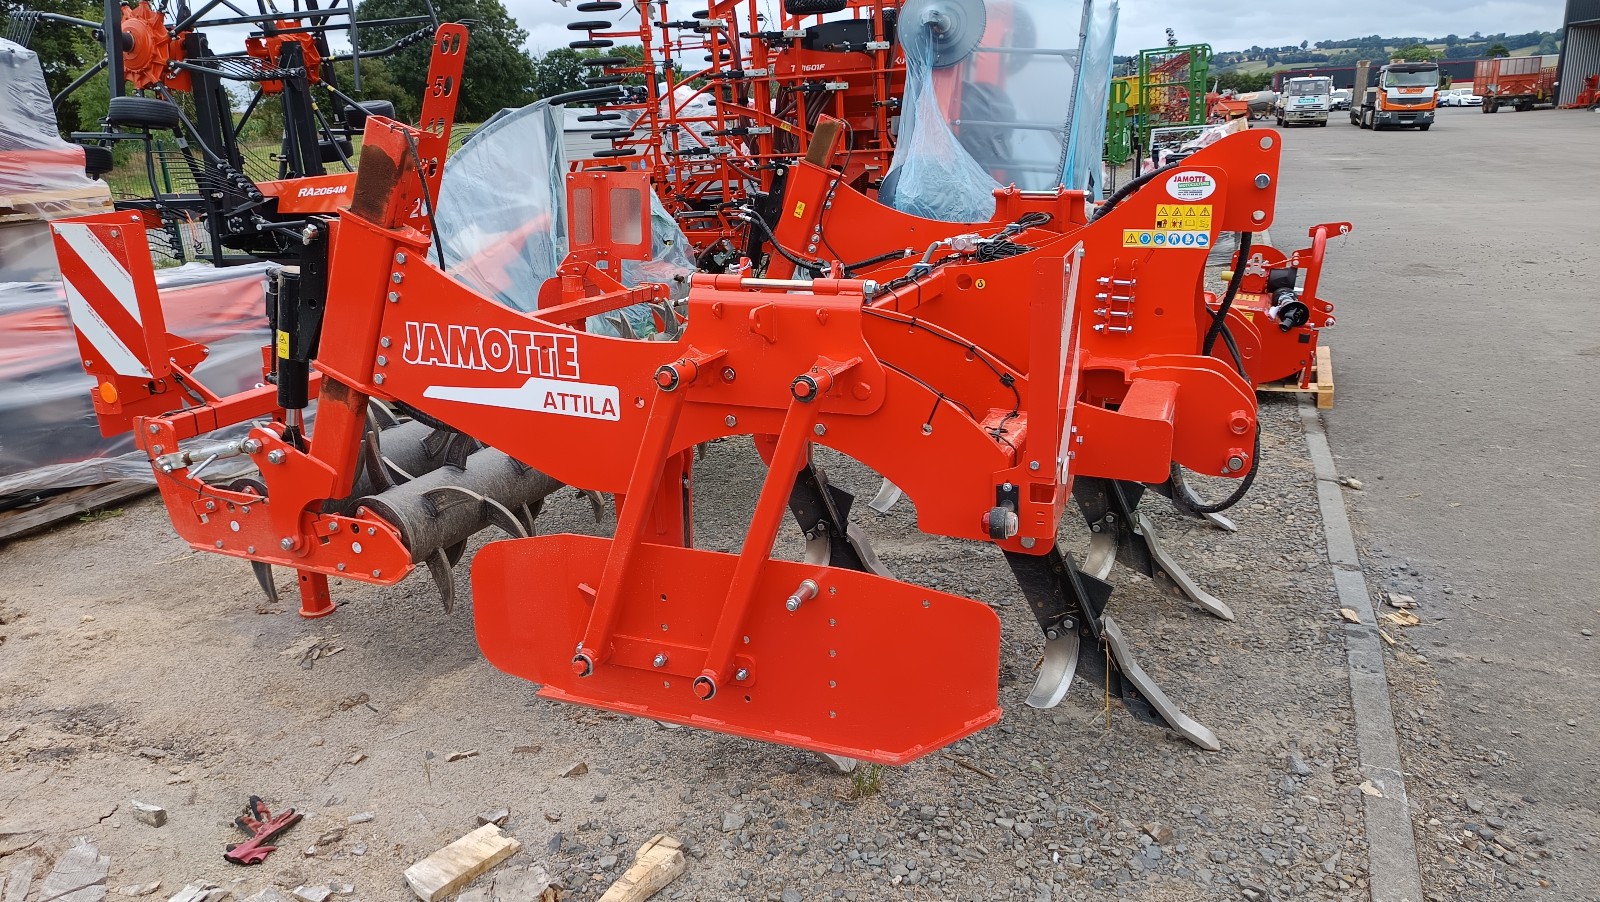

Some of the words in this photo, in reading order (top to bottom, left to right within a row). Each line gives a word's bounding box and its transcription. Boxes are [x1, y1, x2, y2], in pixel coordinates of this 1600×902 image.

[441, 32, 460, 56] 60
[790, 64, 825, 73] T1601F
[433, 75, 454, 98] 50
[297, 185, 348, 198] RA2064M
[402, 321, 580, 380] JAMOTTE
[543, 391, 617, 417] ATTILA
